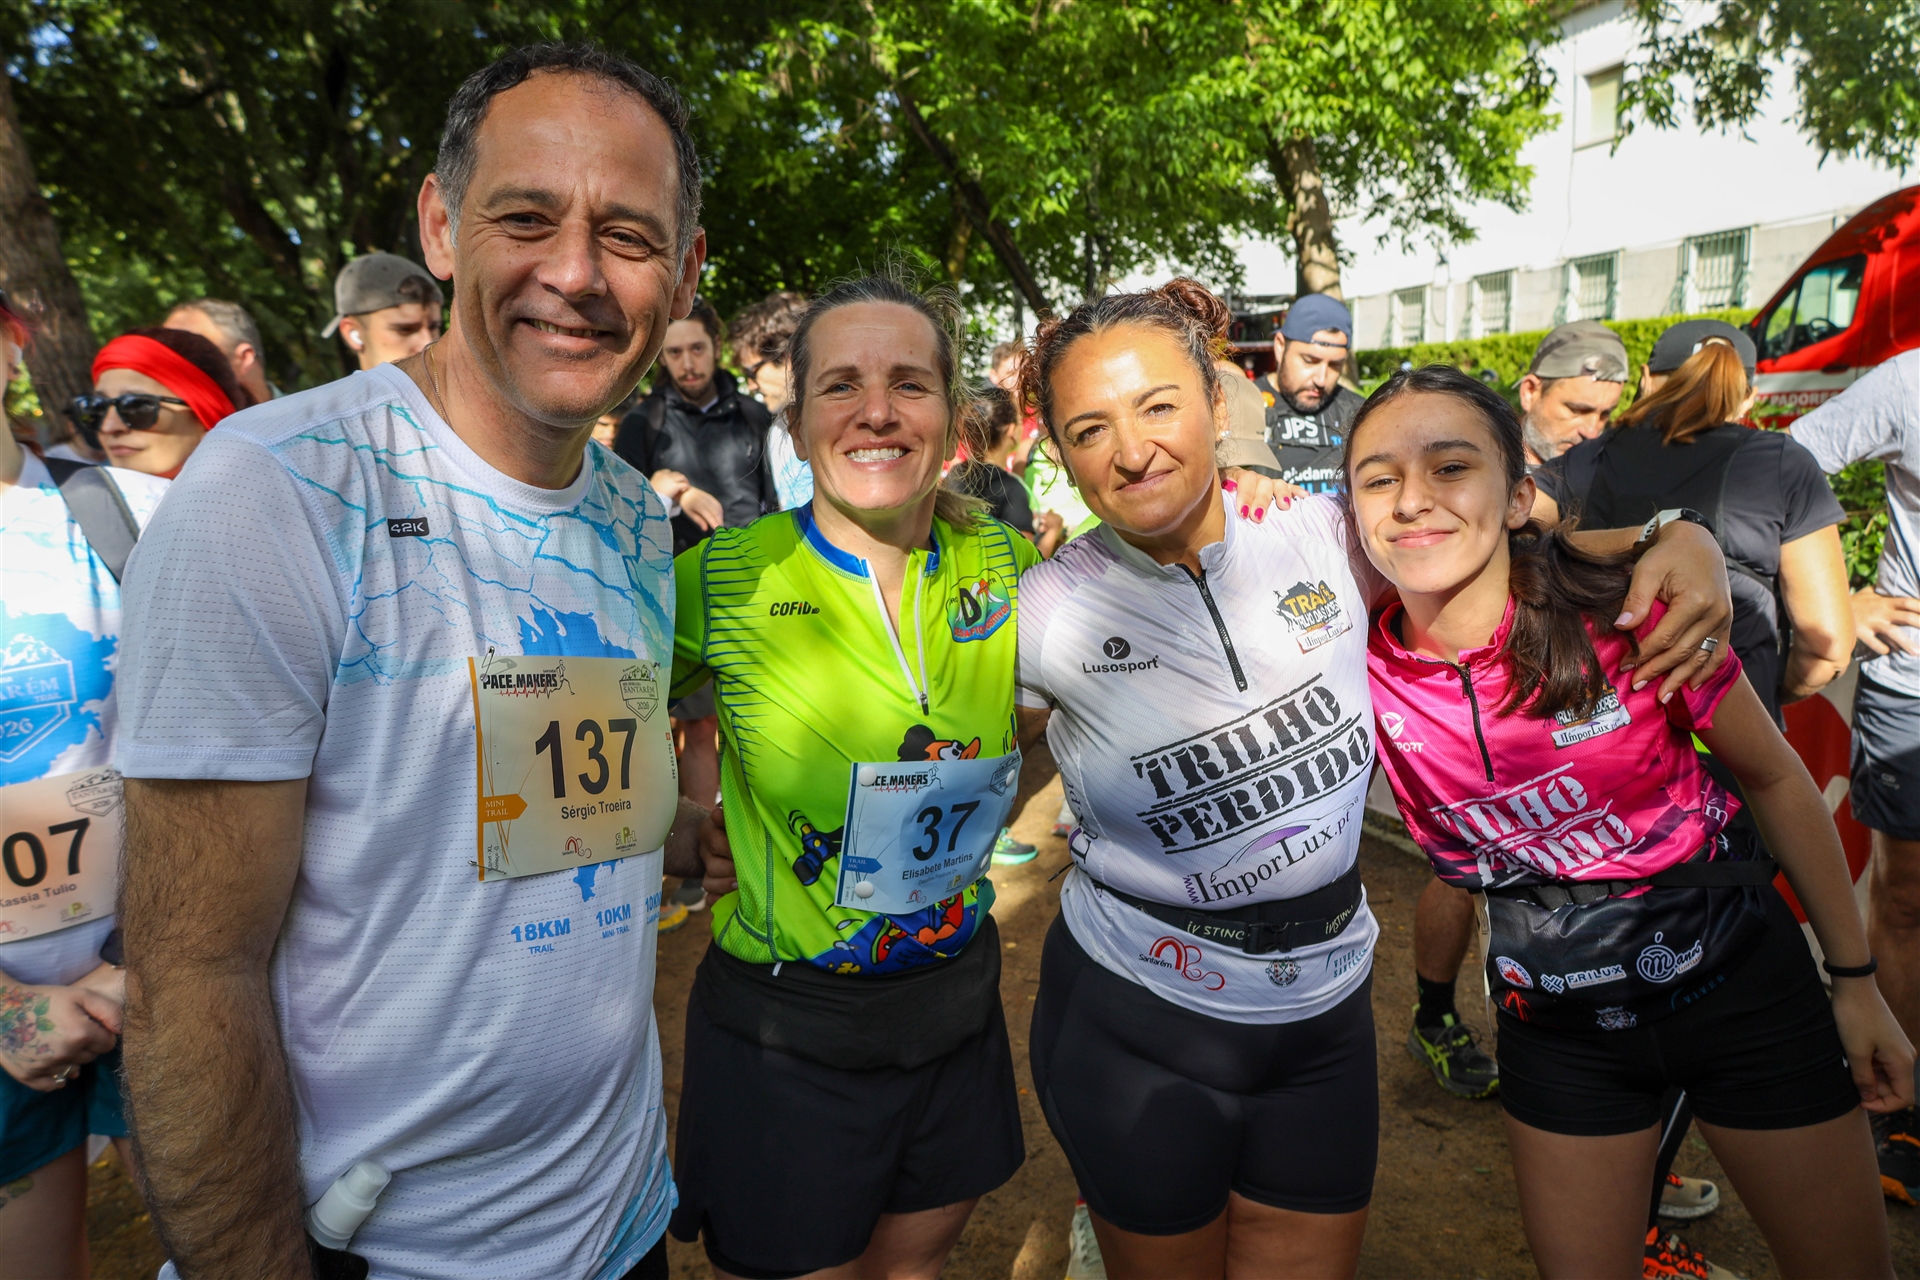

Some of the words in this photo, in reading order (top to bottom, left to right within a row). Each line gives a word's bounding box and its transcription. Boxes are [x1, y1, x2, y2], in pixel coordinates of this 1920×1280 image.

[1281, 415, 1318, 440] JPS
[1283, 466, 1345, 484] ajudam
[1284, 584, 1336, 617] TRAIL
[1082, 657, 1159, 674] Lusosport
[1133, 686, 1341, 798] TRILHO
[535, 718, 638, 799] 137
[861, 774, 929, 787] CE.MAKERS
[1142, 725, 1370, 848] PERDIDO
[485, 800, 504, 808] MINI
[486, 808, 508, 817] TRAIL
[561, 804, 597, 820] Sérgio
[598, 799, 632, 814] Troeira
[912, 800, 981, 862] 37
[849, 857, 867, 865] TRAIL
[902, 863, 942, 880] Elisabete
[943, 853, 973, 868] Martins
[43, 883, 77, 897] Tulio
[596, 903, 631, 927] 10KM
[510, 918, 571, 943] 18KM
[602, 929, 615, 939] MINI
[616, 925, 630, 935] TRAIL
[529, 943, 555, 955] TRAIL
[1138, 953, 1173, 969] Santarém
[1333, 949, 1355, 968] VIVER
[1567, 965, 1623, 983] FRILUX
